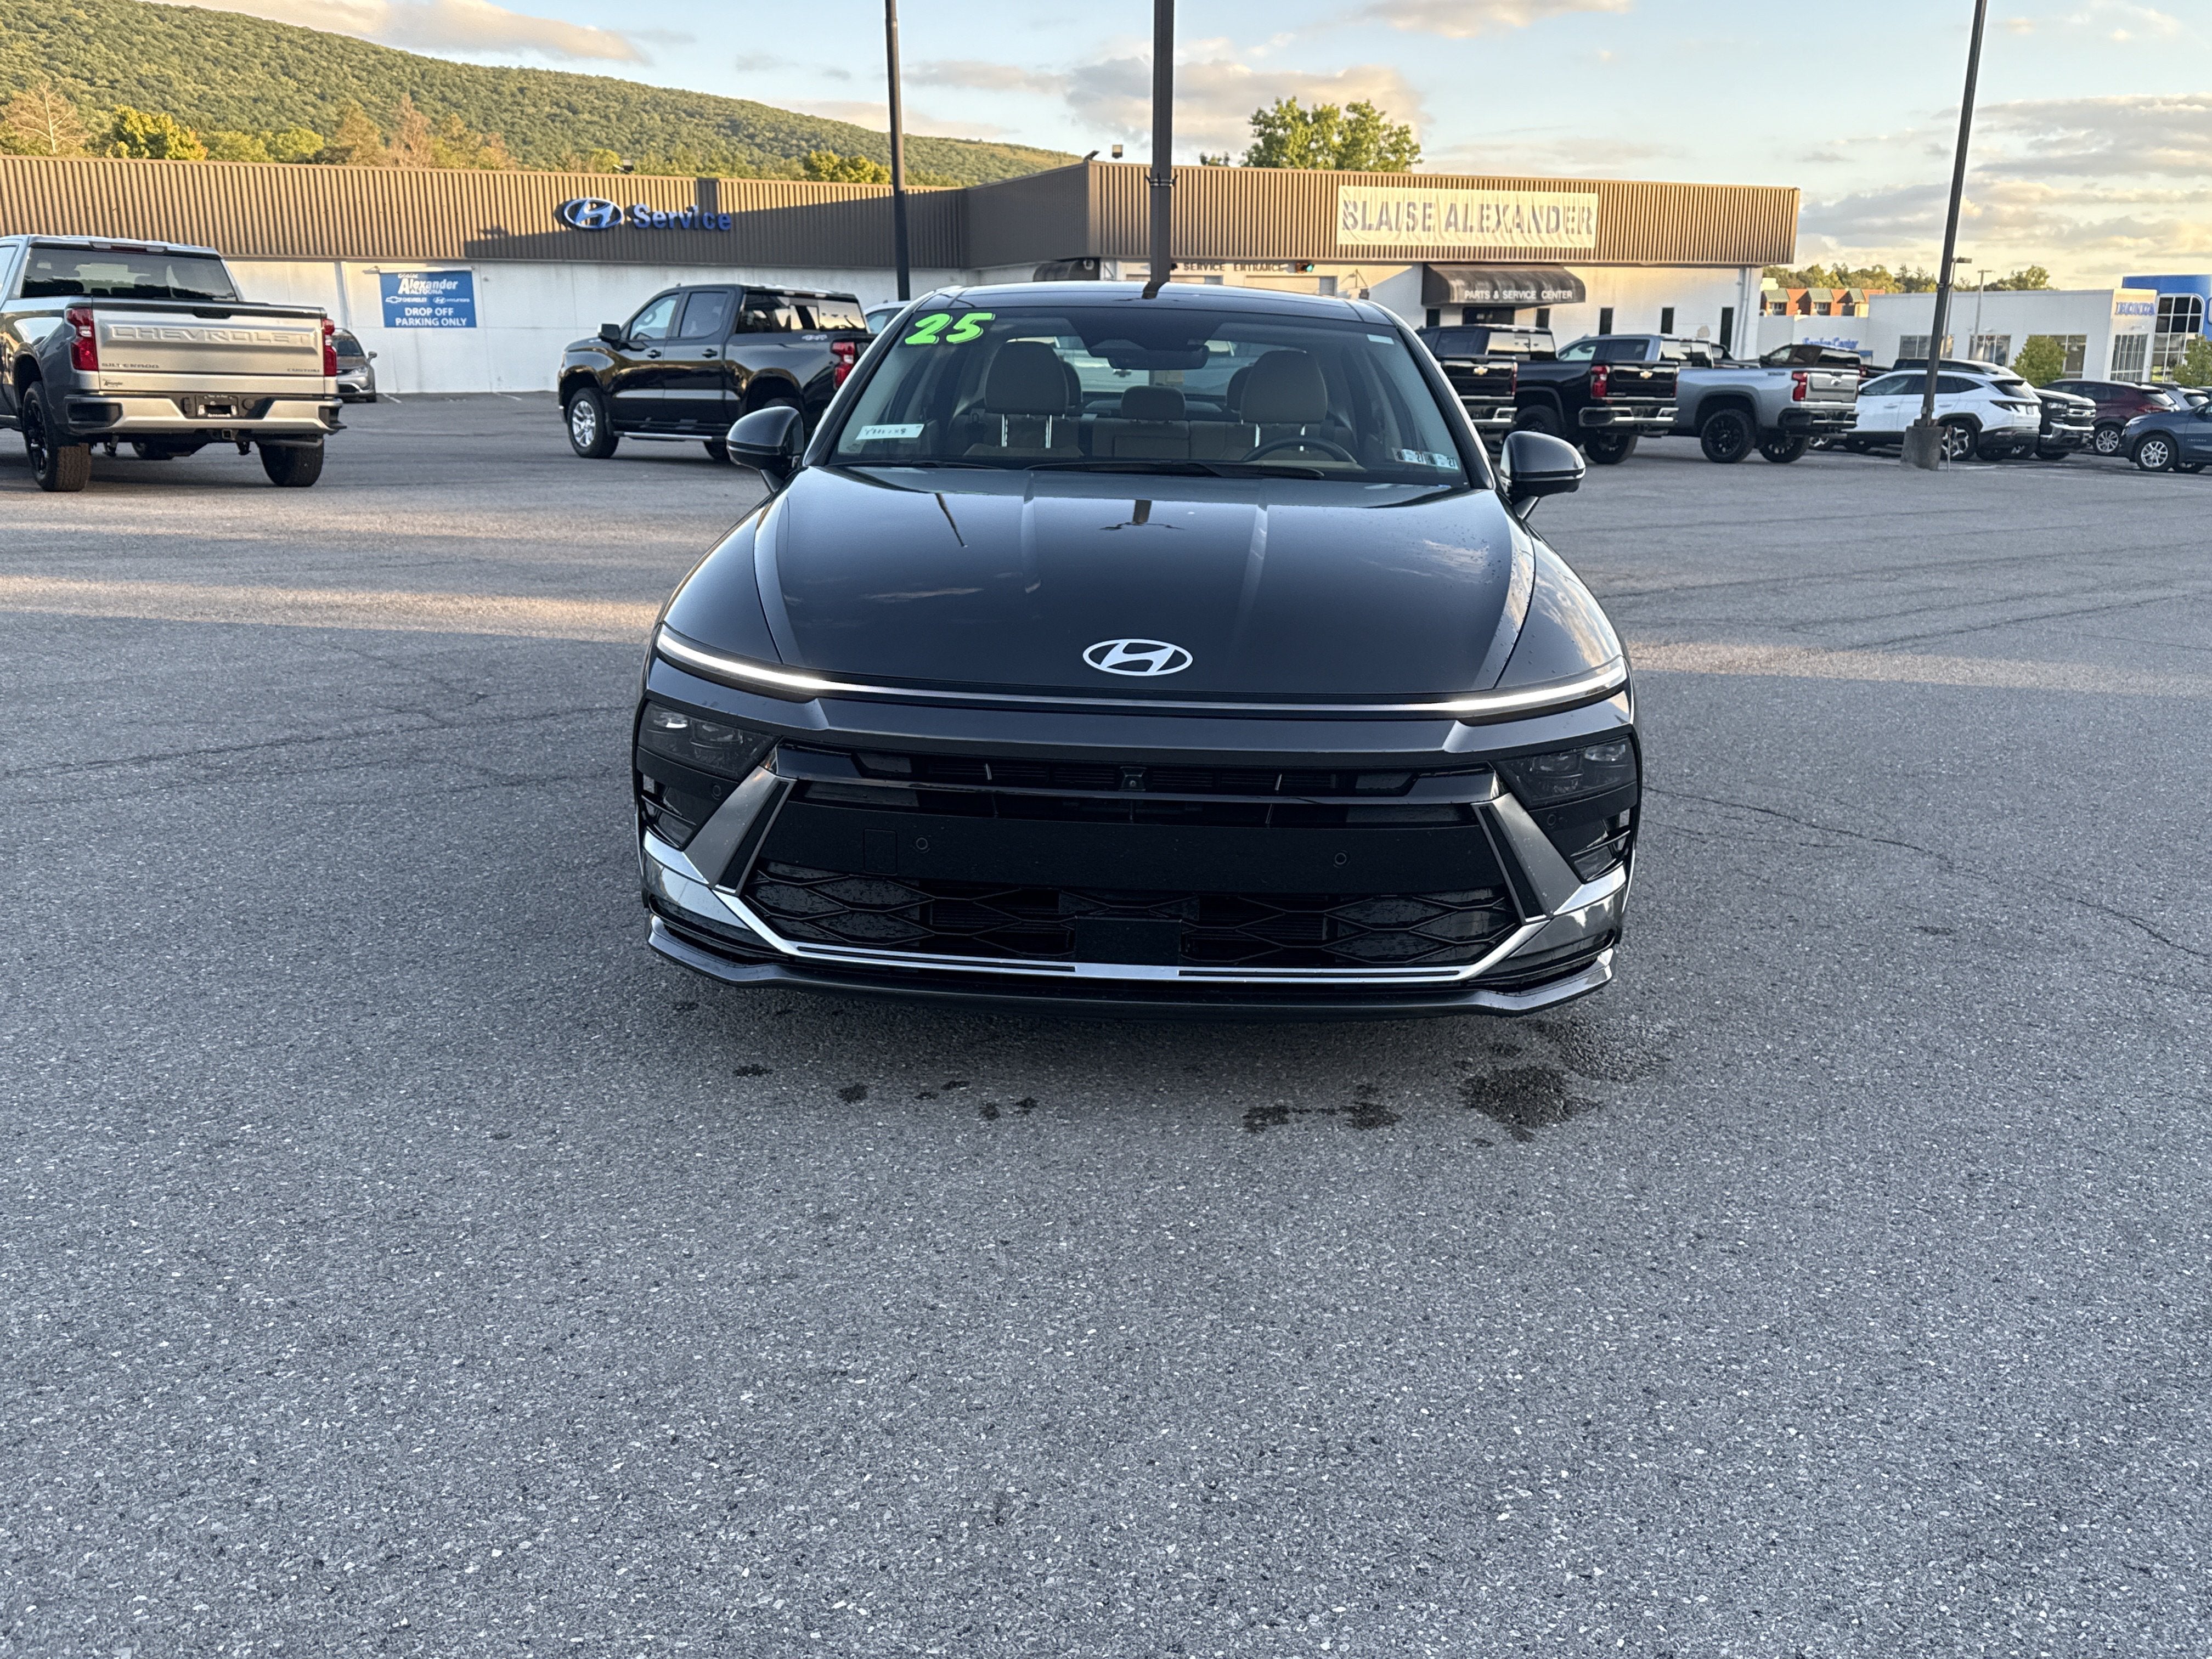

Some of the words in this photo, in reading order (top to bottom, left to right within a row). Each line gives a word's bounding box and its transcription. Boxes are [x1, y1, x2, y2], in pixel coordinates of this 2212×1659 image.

[633, 203, 732, 231] Service
[1342, 200, 1436, 233] BLAISE
[1444, 203, 1593, 235] ALEXANDER
[1183, 262, 1226, 272] SERVICE
[398, 278, 458, 295] Alexander
[1464, 290, 1491, 300] PARTS
[1493, 291, 1499, 300] &
[1502, 290, 1536, 300] SERVICE
[1541, 290, 1573, 300] CENTER
[404, 307, 433, 317] DROP
[435, 307, 454, 316] OFF
[2115, 302, 2155, 315] HONDA
[395, 317, 438, 326] PARKING
[441, 317, 467, 326] ONLY
[905, 313, 996, 345] 25
[111, 327, 309, 344] CHEVROLET
